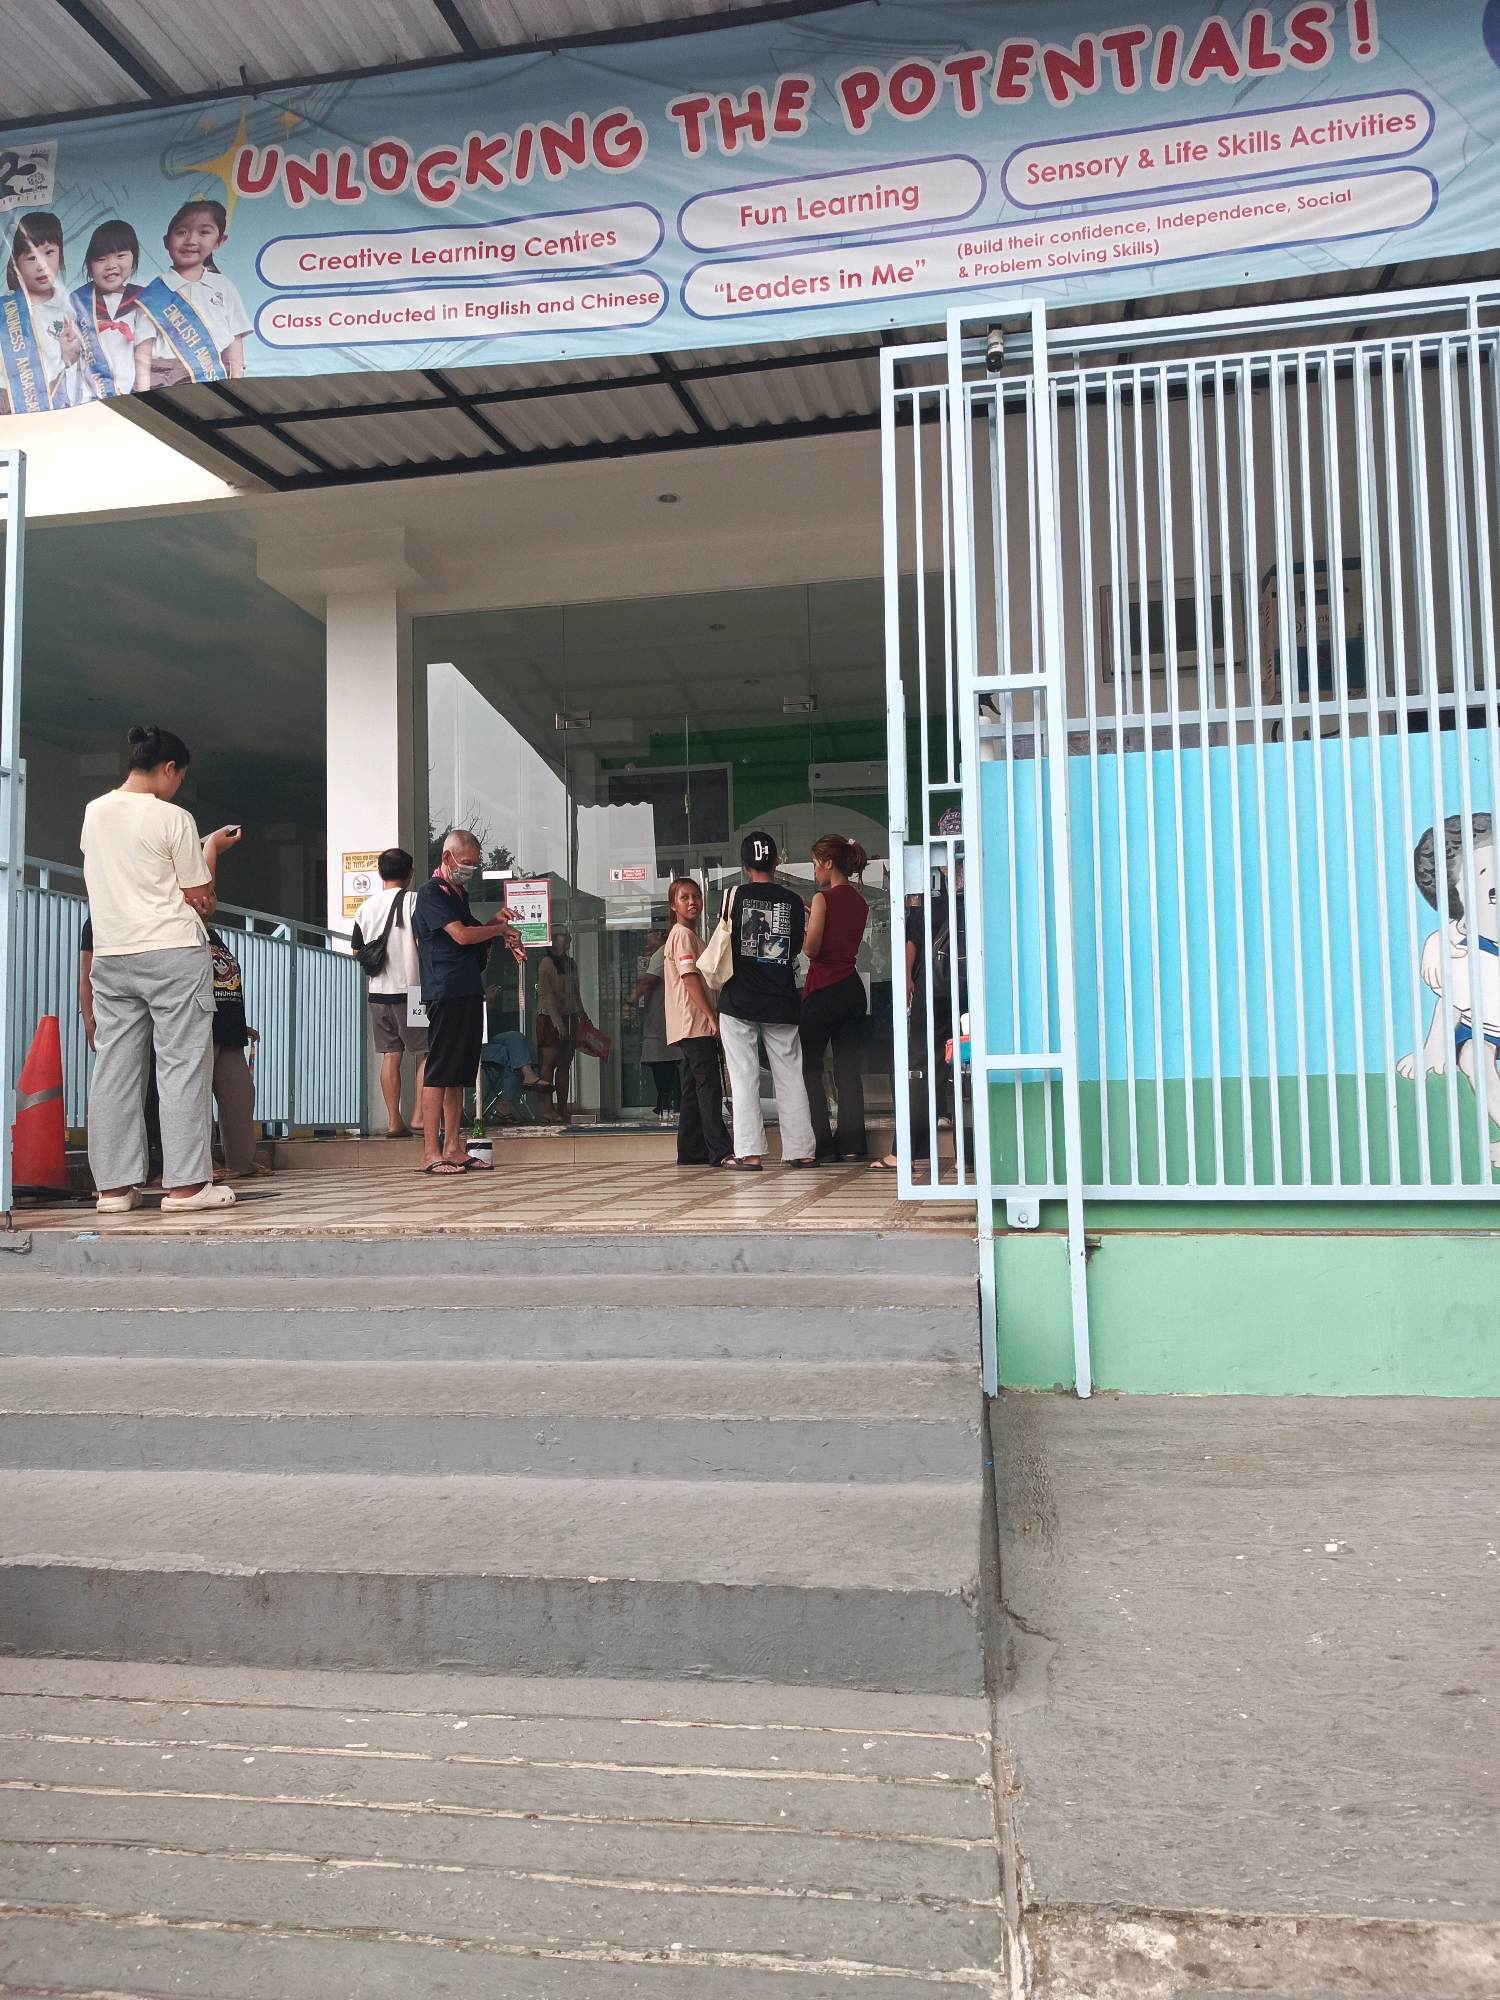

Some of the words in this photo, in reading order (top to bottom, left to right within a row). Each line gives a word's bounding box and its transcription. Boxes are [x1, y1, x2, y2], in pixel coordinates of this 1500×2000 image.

[237, 113, 642, 204] UNLOCKING
[672, 80, 809, 152] THE
[1027, 153, 1129, 185] Sensory
[1138, 148, 1154, 169] &
[1164, 141, 1209, 165] Life
[1218, 130, 1281, 158] Skills
[1290, 114, 1416, 148] Activities
[741, 206, 786, 227] Fun
[797, 184, 920, 222] Learning
[958, 240, 1002, 259] (Build
[1007, 232, 1045, 251] their
[1049, 219, 1152, 246] confidence,
[1156, 200, 1292, 230] Independence,
[1298, 191, 1352, 210] Social
[298, 249, 403, 272] Creative
[412, 242, 516, 264] Learning
[525, 231, 616, 257] Centres
[958, 265, 969, 278] &
[974, 257, 1043, 276] Problem
[1048, 250, 1107, 266] Solving
[1113, 240, 1160, 259] Skills)
[840, 269, 862, 289] in
[3, 299, 26, 353] KINDNESS
[162, 303, 203, 348] ENGLISH
[271, 312, 323, 329] Class
[329, 306, 435, 326] Conducted
[443, 302, 459, 320] in
[465, 300, 531, 321] English
[537, 297, 574, 314] and
[582, 292, 659, 310] Chinese
[80, 317, 97, 367] CHINESE
[412, 1008, 422, 1016] K2
